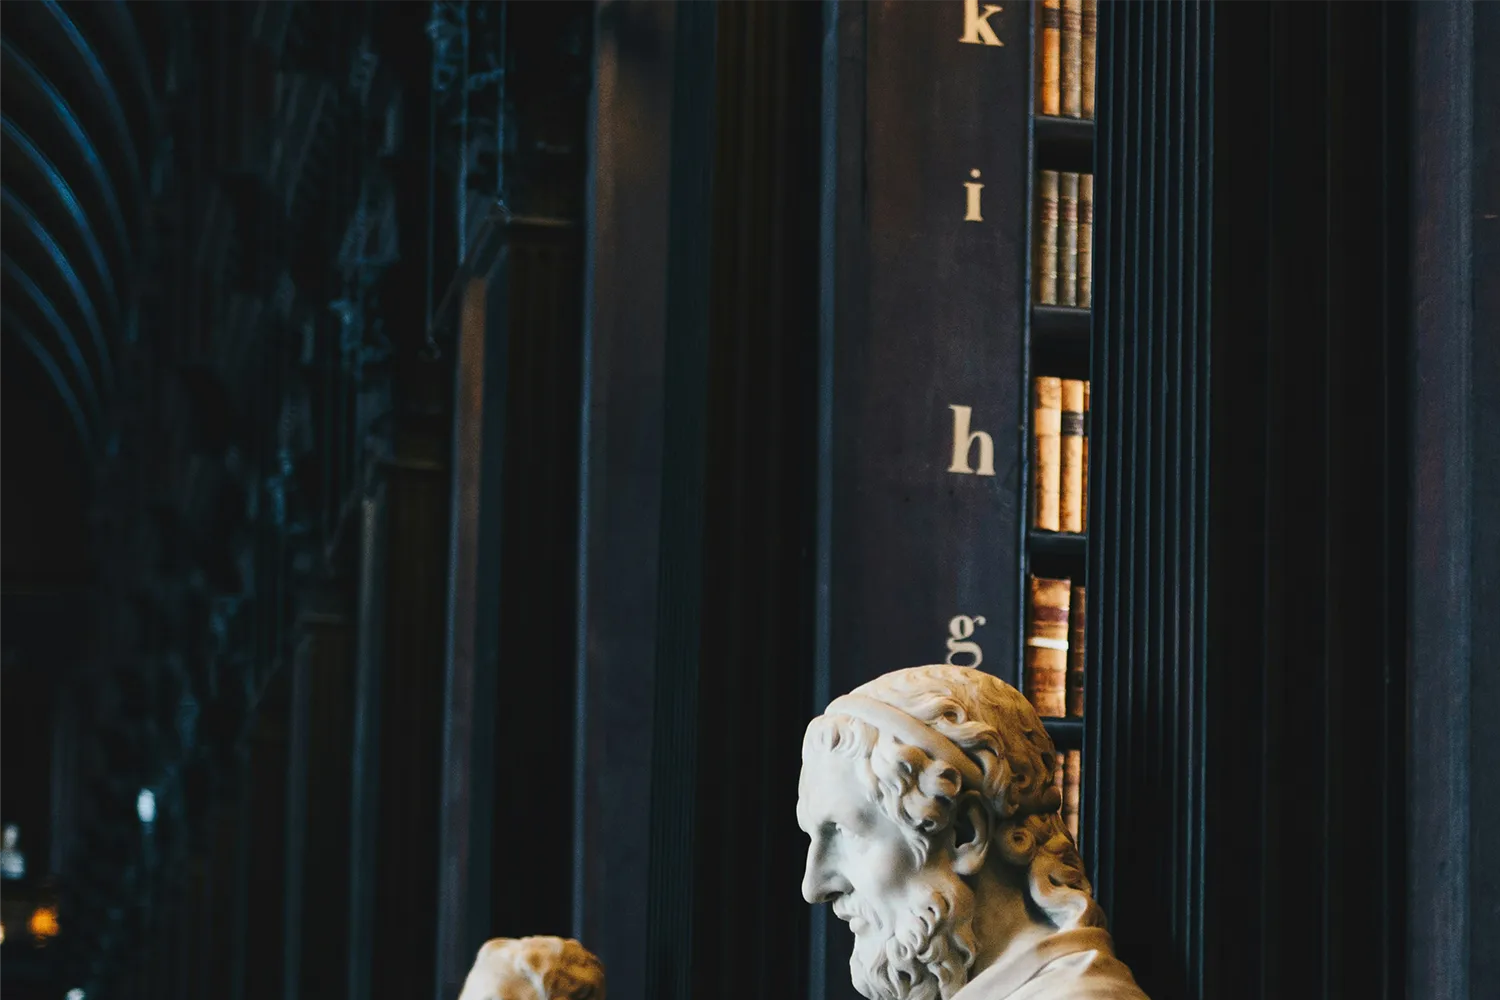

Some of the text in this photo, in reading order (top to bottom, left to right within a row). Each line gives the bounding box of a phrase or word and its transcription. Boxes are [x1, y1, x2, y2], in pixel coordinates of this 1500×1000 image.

[959, 0, 1004, 47] k
[964, 169, 984, 221] i
[948, 404, 996, 475] h
[946, 615, 986, 669] g
